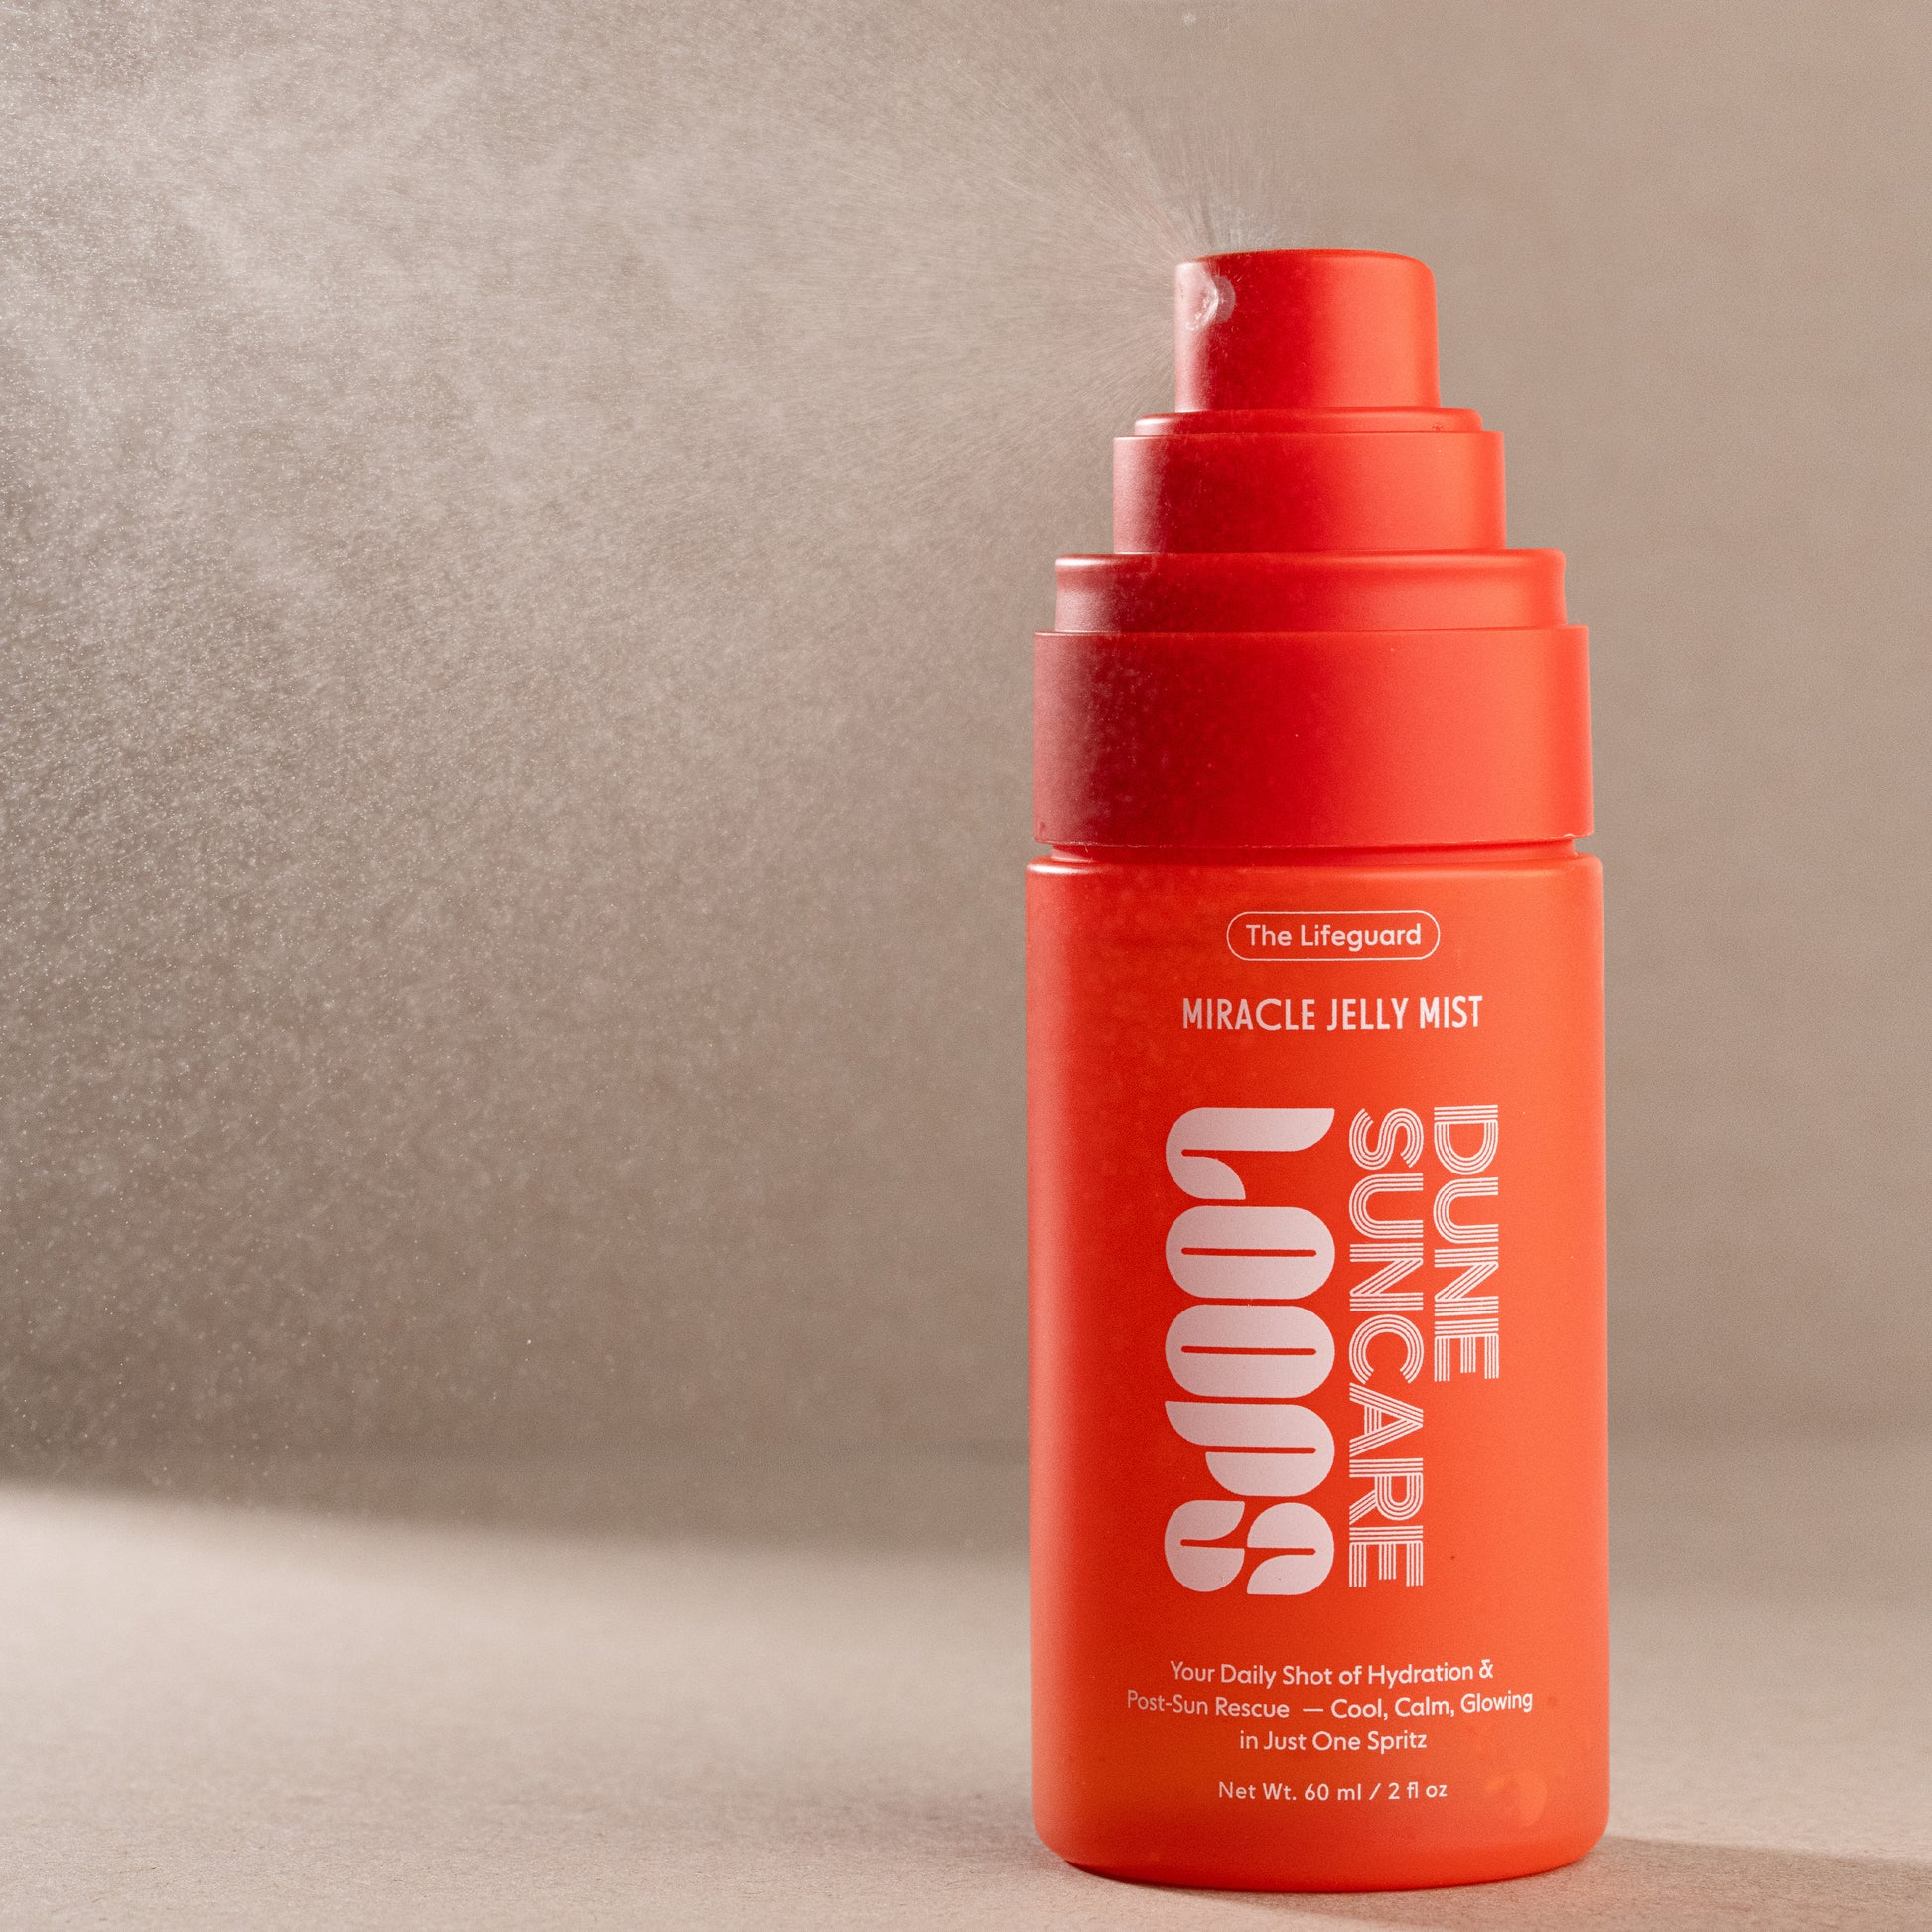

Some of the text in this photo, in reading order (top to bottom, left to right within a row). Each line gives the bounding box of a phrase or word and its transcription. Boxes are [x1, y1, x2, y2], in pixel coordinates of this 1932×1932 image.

[1246, 923, 1422, 952] The Lifeguard
[1182, 995, 1483, 1030] MIRACLE JELLY MIST
[1433, 1104, 1500, 1382] DUNE
[1165, 1107, 1335, 1595] LOOPS
[1348, 1107, 1424, 1588] SUNCARE
[1171, 1659, 1494, 1689] Your Daily Shot of Hydration &
[1127, 1690, 1208, 1716] Post-Sun
[1215, 1697, 1290, 1718] Rescue
[1330, 1697, 1389, 1721] Cool,
[1394, 1695, 1455, 1718] Calm,
[1460, 1691, 1533, 1713] Glowing
[1239, 1730, 1428, 1754] in Just One Spritz
[1219, 1781, 1448, 1802] Net Wt. 60 ml / 2 fl oz
